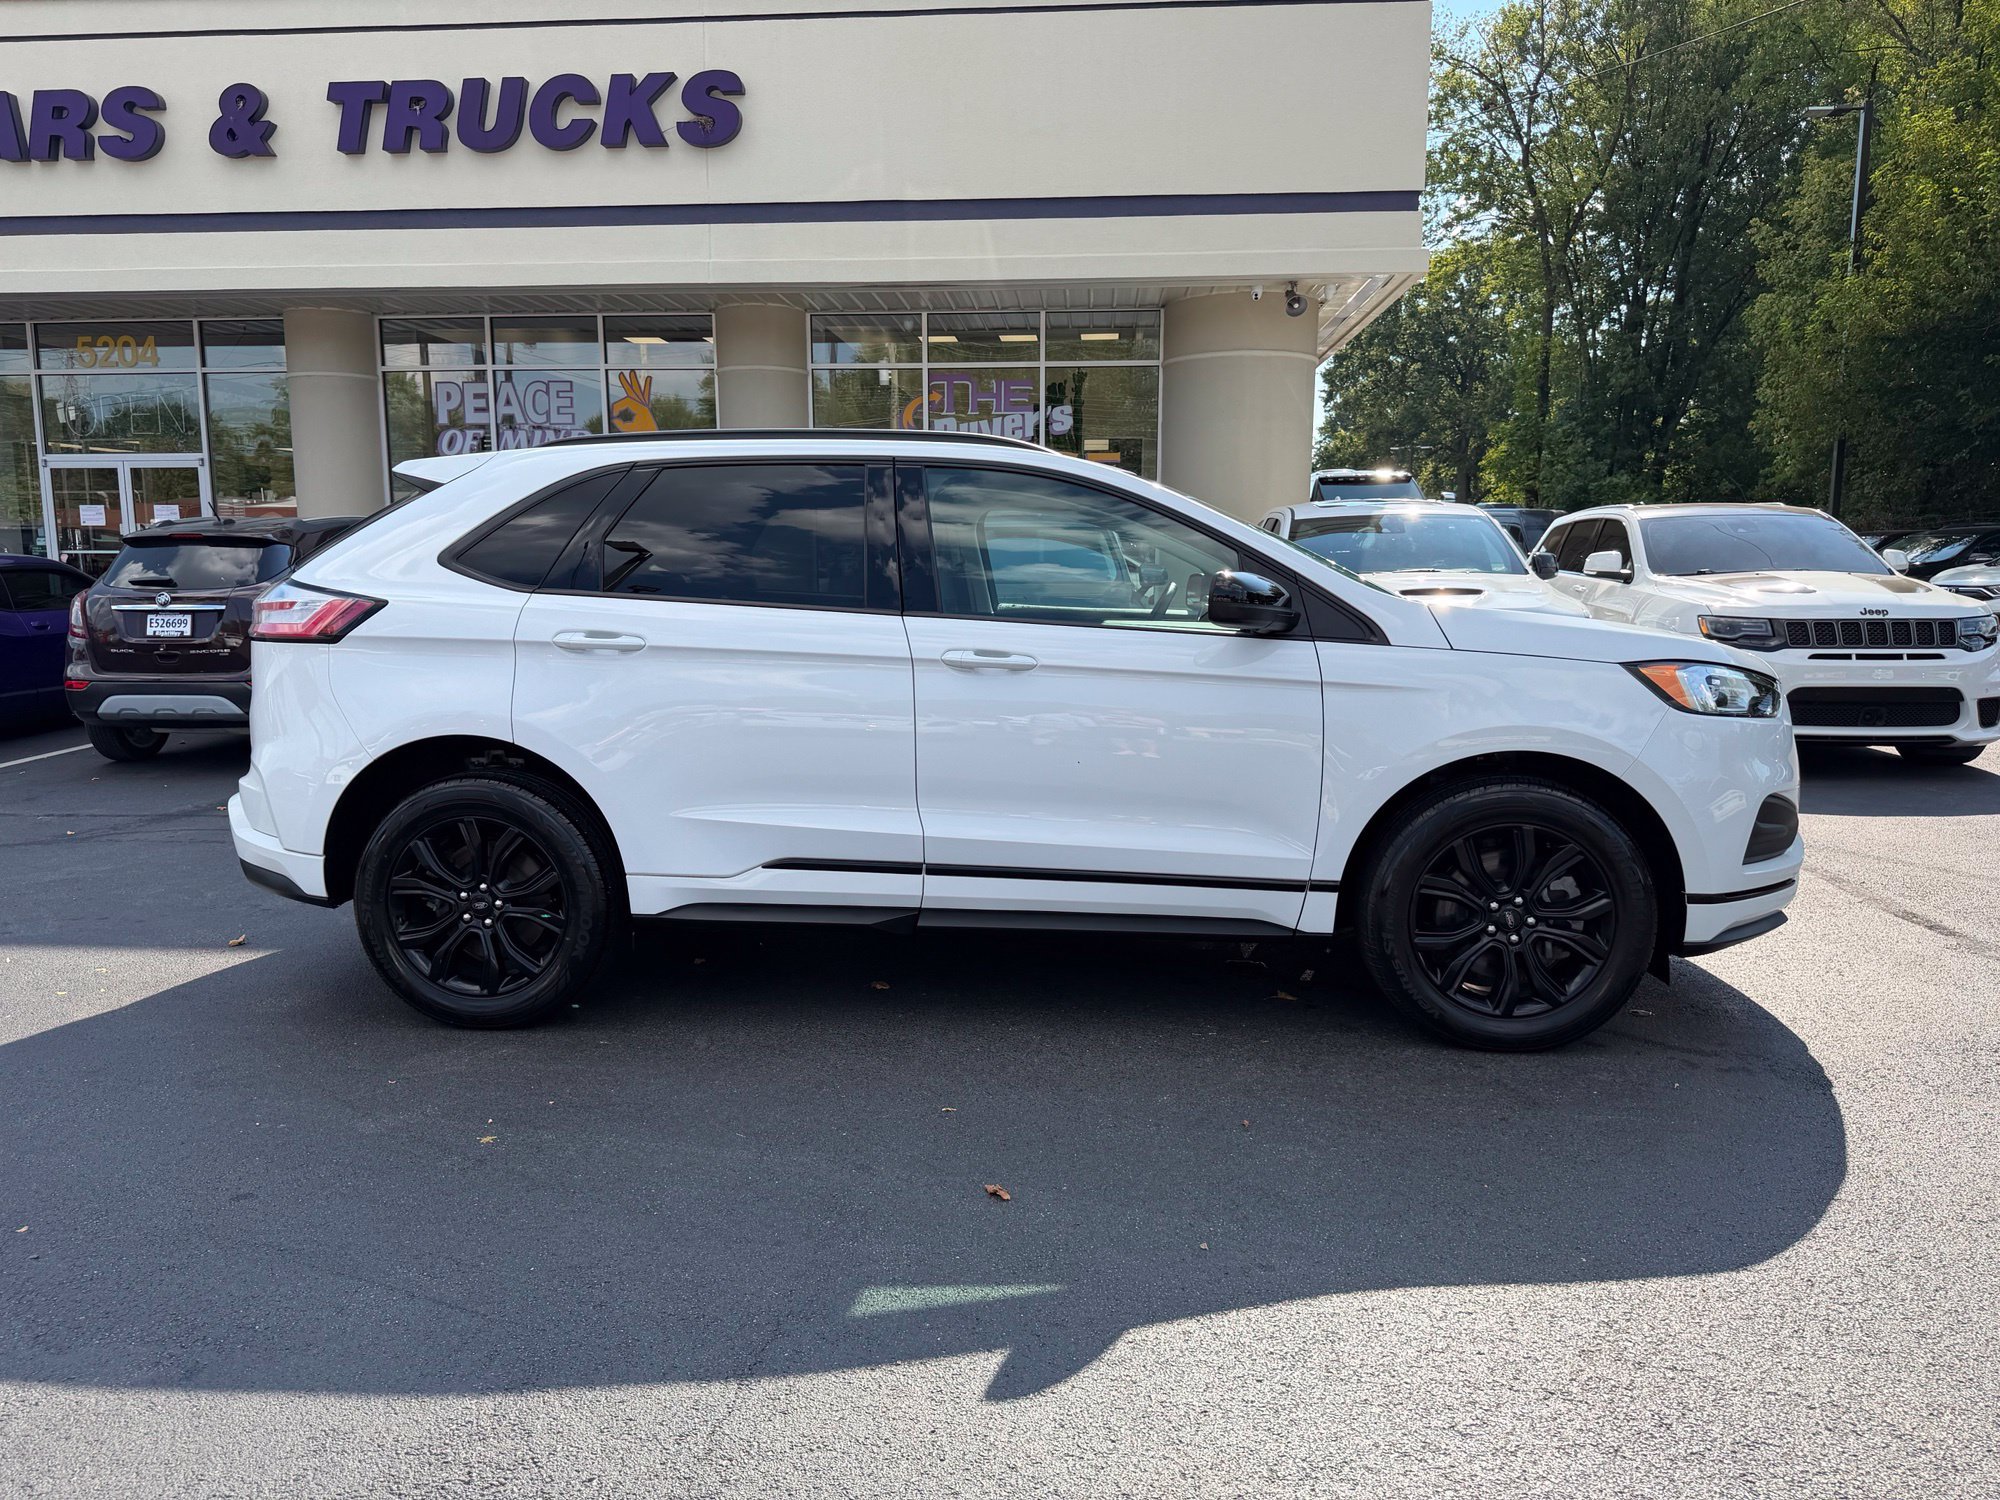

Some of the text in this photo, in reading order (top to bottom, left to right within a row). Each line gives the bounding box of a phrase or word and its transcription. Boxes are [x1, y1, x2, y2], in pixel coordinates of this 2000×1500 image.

[209, 83, 278, 159] &
[326, 69, 747, 156] TRUCKS
[75, 335, 160, 368] 5204
[65, 390, 187, 437] OPEN
[435, 381, 575, 425] PEACE
[927, 373, 1035, 416] THE
[931, 403, 1074, 441] er's
[438, 428, 594, 455] OF MI
[149, 618, 188, 628] E526699
[1860, 607, 1889, 617] Jeep
